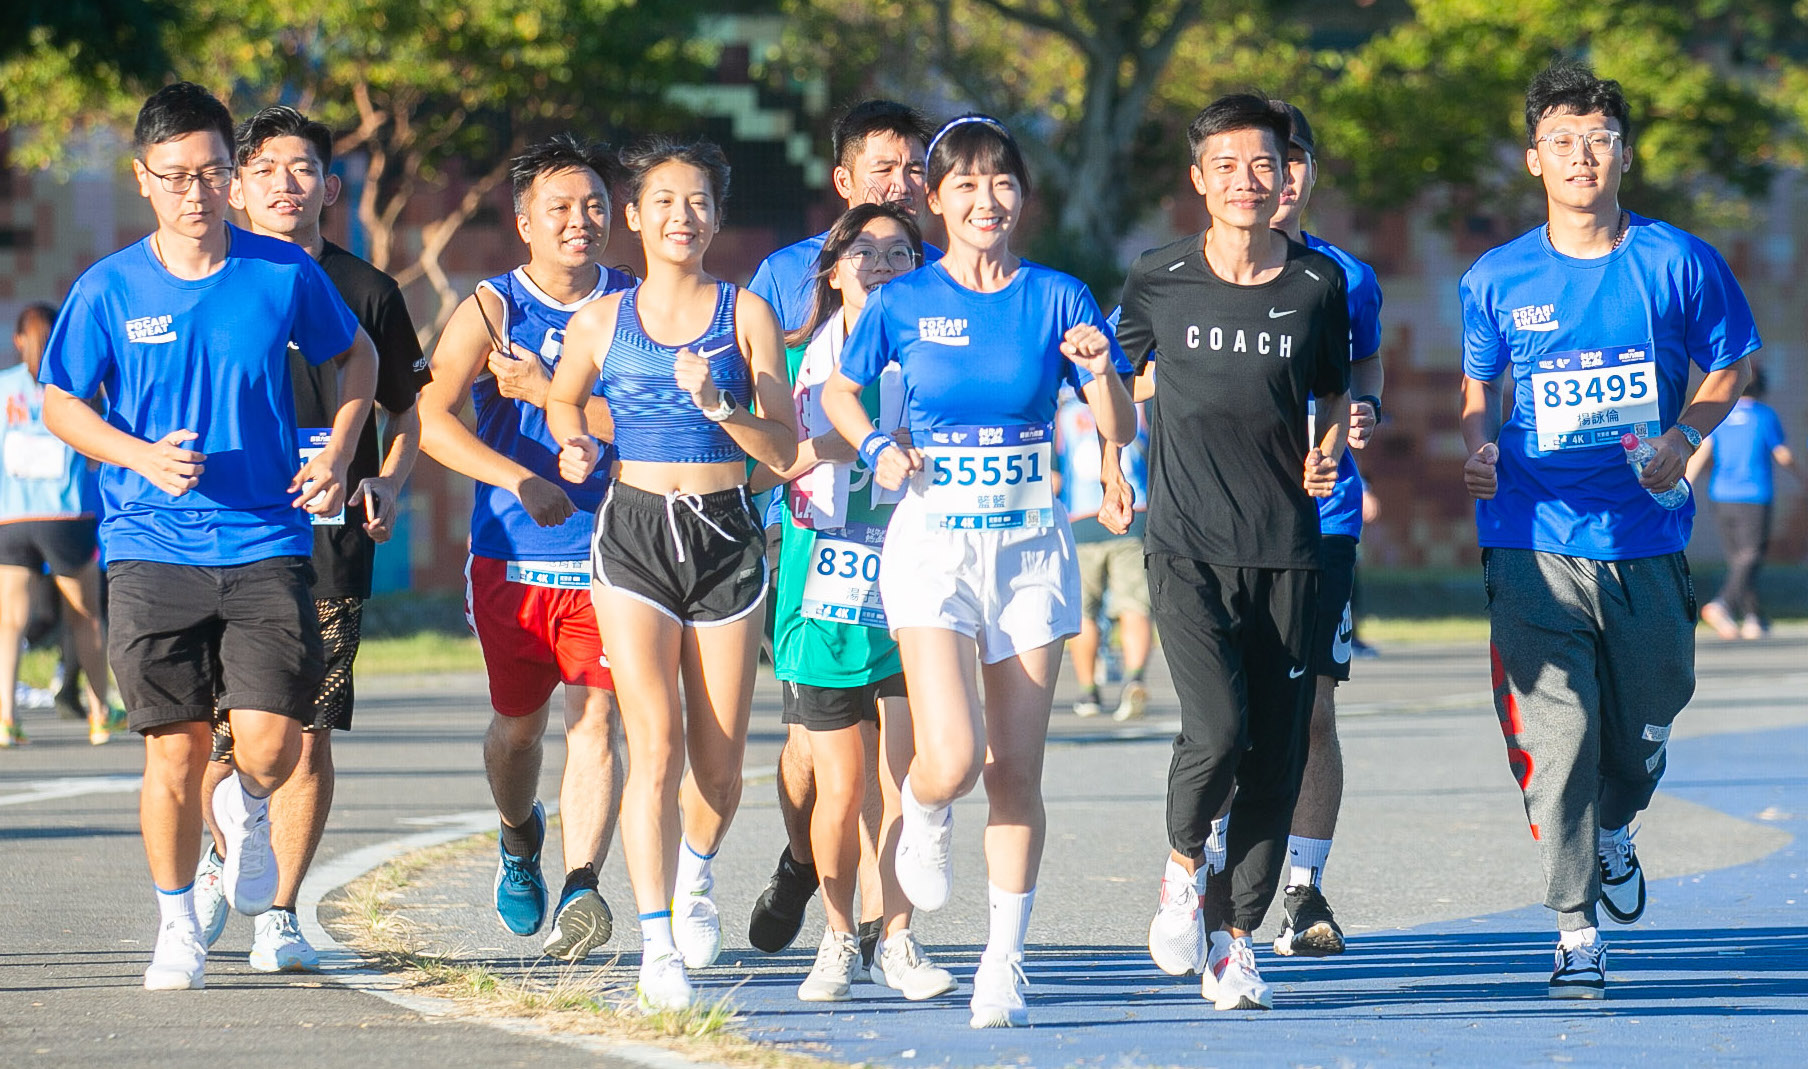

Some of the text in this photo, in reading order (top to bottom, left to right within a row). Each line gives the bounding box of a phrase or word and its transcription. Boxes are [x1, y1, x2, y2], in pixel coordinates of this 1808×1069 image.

[1512, 304, 1554, 320] POCARI
[126, 314, 172, 333] POCARI
[128, 323, 168, 340] SWEAT
[919, 318, 968, 330] POCARI
[1187, 325, 1292, 358] COACH
[1543, 371, 1648, 408] 83495
[1577, 409, 1620, 426] 楊詠倫
[1572, 435, 1585, 444] 4K
[932, 452, 1043, 486] 55551
[960, 516, 975, 528] 4K
[536, 573, 549, 584] 4K
[835, 607, 849, 619] 4K
